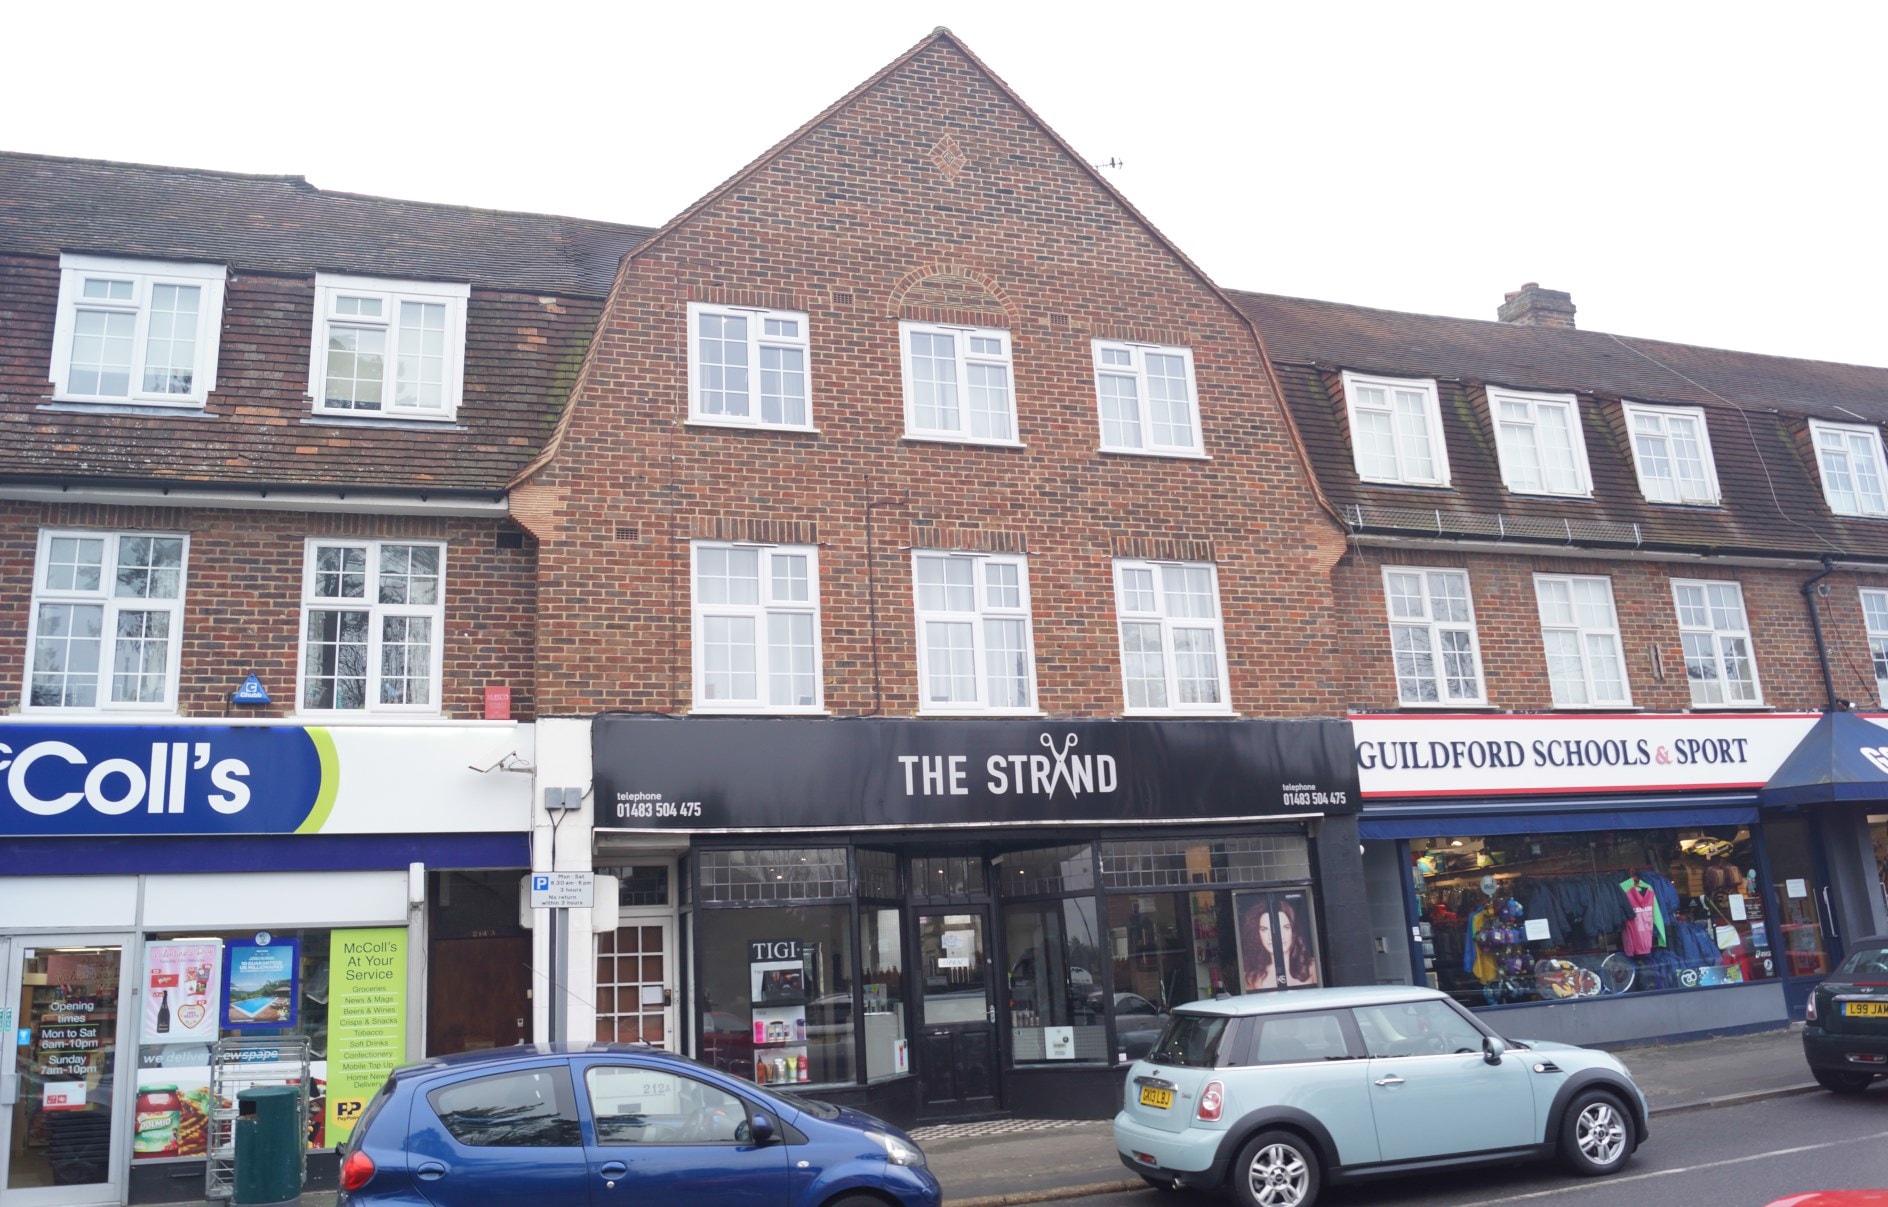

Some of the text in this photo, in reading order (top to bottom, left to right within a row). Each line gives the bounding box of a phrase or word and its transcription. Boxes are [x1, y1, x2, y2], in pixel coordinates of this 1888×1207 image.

[1357, 738, 1748, 770] GUILDFORD SCHOOLS & SPORT
[898, 733, 1118, 800] THE STRAND
[1282, 783, 1316, 792] telephone
[617, 792, 662, 802] telephone
[1283, 791, 1347, 805] 01483 504 475
[617, 802, 702, 817] 01483 504 475
[536, 877, 548, 890] P
[344, 942, 398, 954] McColl's
[753, 941, 796, 960] TIGI
[347, 955, 394, 967] At Your
[346, 969, 393, 981] Service
[374, 996, 394, 1004] Mags
[50, 1001, 94, 1012] Opening
[1850, 1004, 1868, 1014] L99
[57, 1014, 86, 1023] times
[372, 1017, 398, 1025] Snacks
[42, 1028, 97, 1039] Mon to Sat
[42, 1039, 98, 1049] 6am-10pm
[49, 1055, 86, 1065] Sunday
[143, 1051, 212, 1063] we deliver
[344, 1051, 393, 1060] Confectionery
[40, 1065, 97, 1075] 7am-10pm
[369, 1062, 382, 1070] Top
[354, 1081, 382, 1089] Delivery
[643, 1083, 672, 1094] 212A
[1156, 1090, 1171, 1105] LBJ
[140, 1118, 171, 1129] DOLMIO
